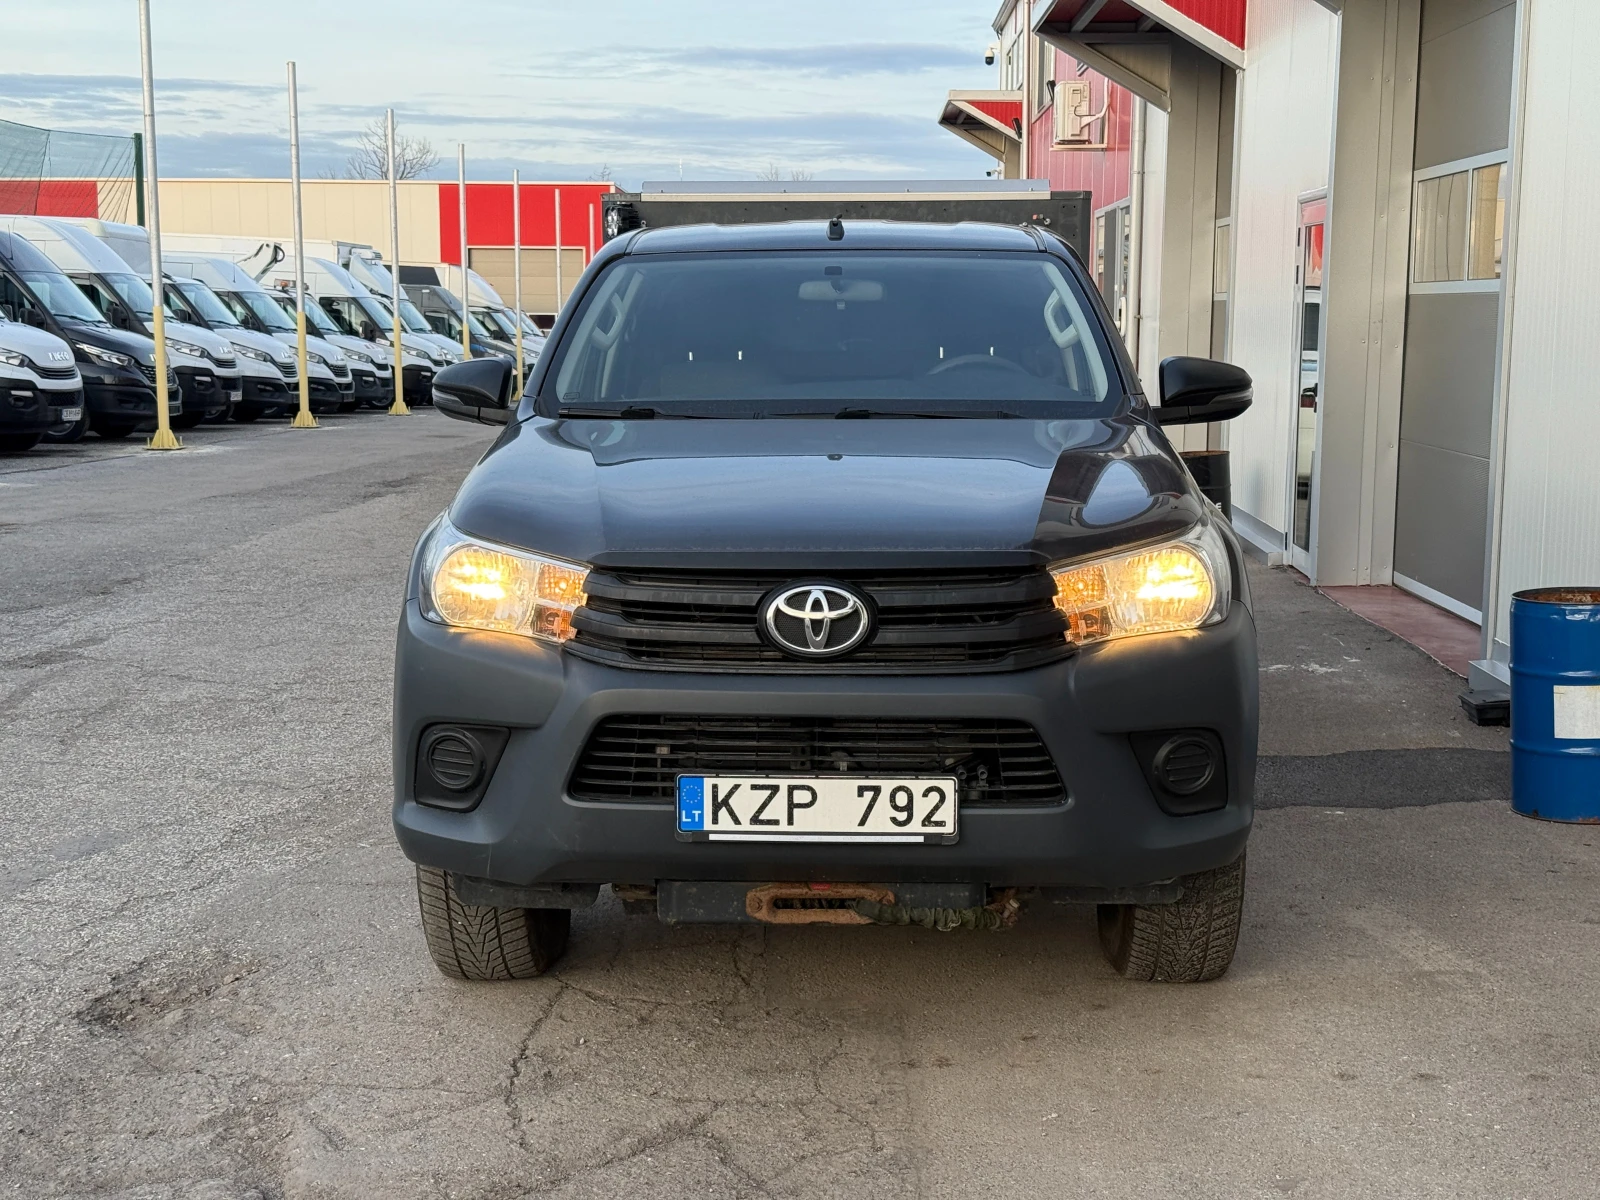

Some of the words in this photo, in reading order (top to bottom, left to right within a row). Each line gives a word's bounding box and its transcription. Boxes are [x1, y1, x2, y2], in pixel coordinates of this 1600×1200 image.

[682, 810, 702, 822] LT
[711, 783, 818, 826] KZP
[856, 785, 947, 827] 792
